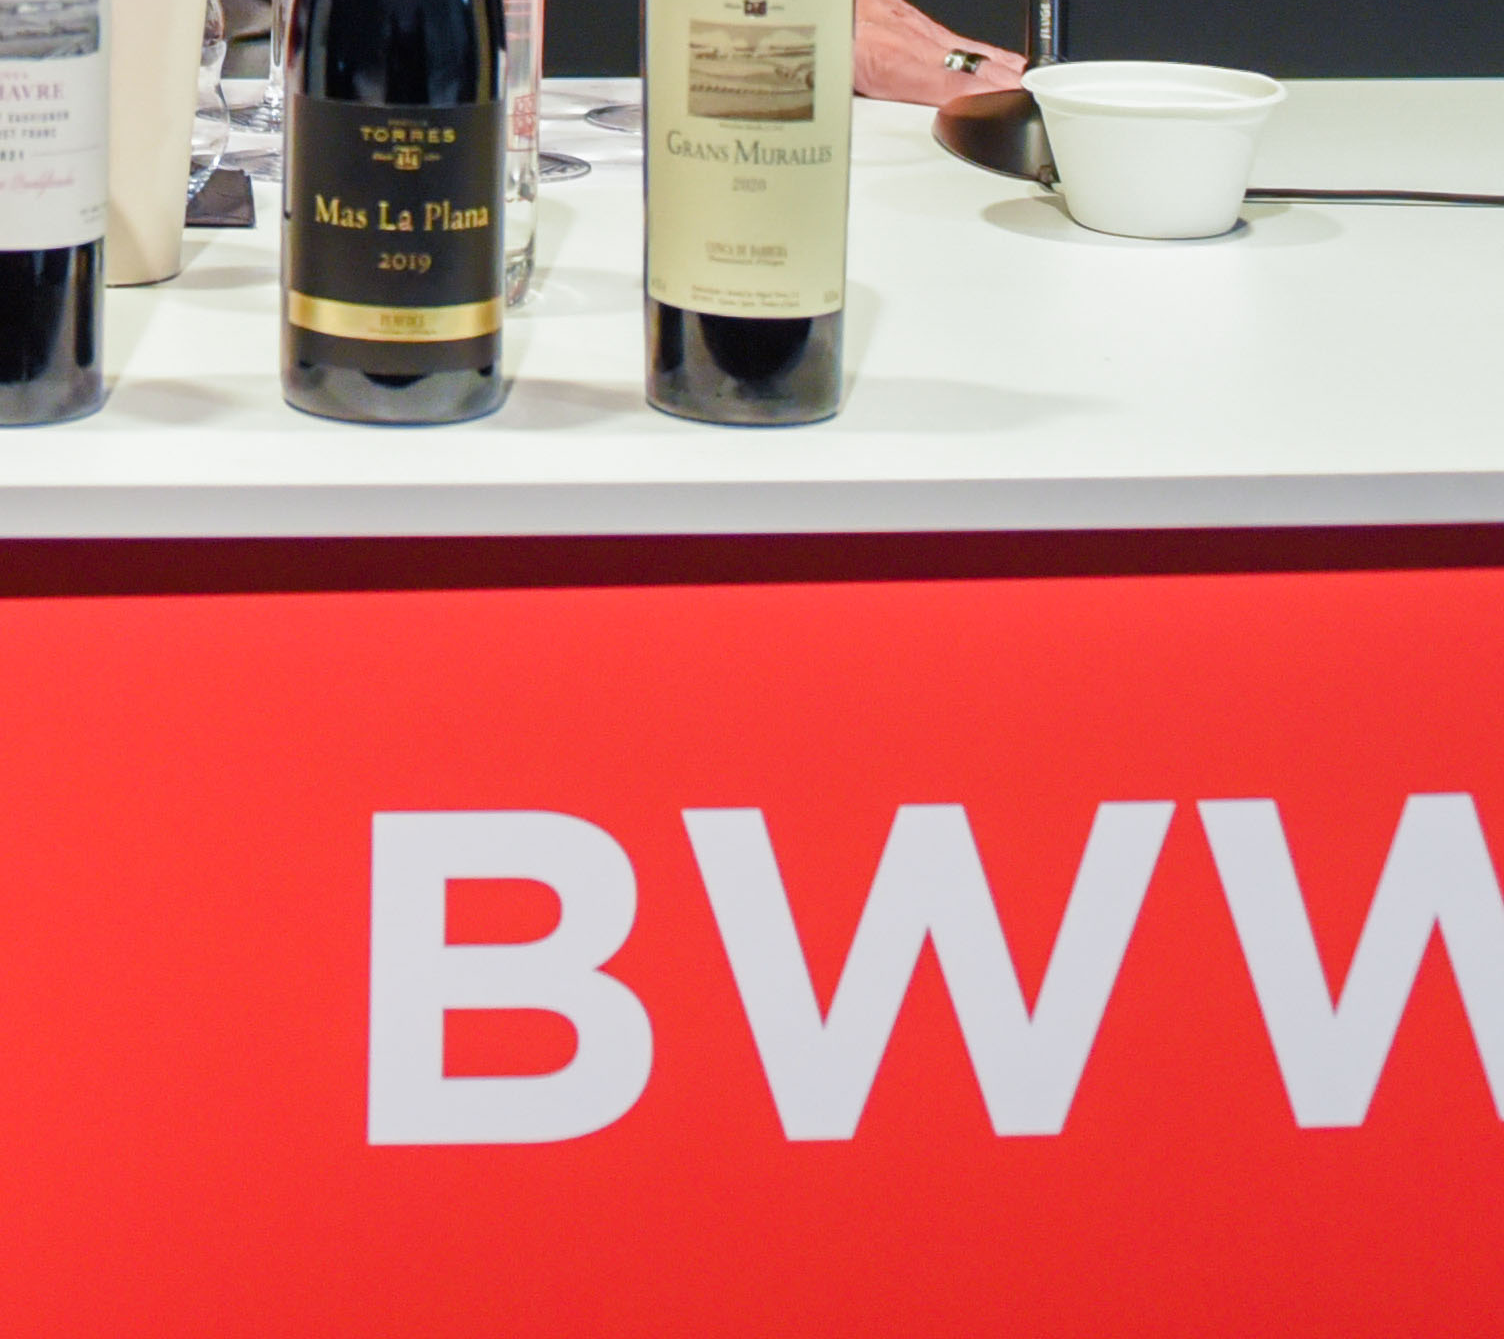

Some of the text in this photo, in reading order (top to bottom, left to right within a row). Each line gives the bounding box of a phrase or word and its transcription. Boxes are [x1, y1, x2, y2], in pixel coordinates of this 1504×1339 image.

[360, 126, 457, 143] TORRES
[314, 193, 490, 232] Mas La Plana
[377, 252, 432, 274] 2019
